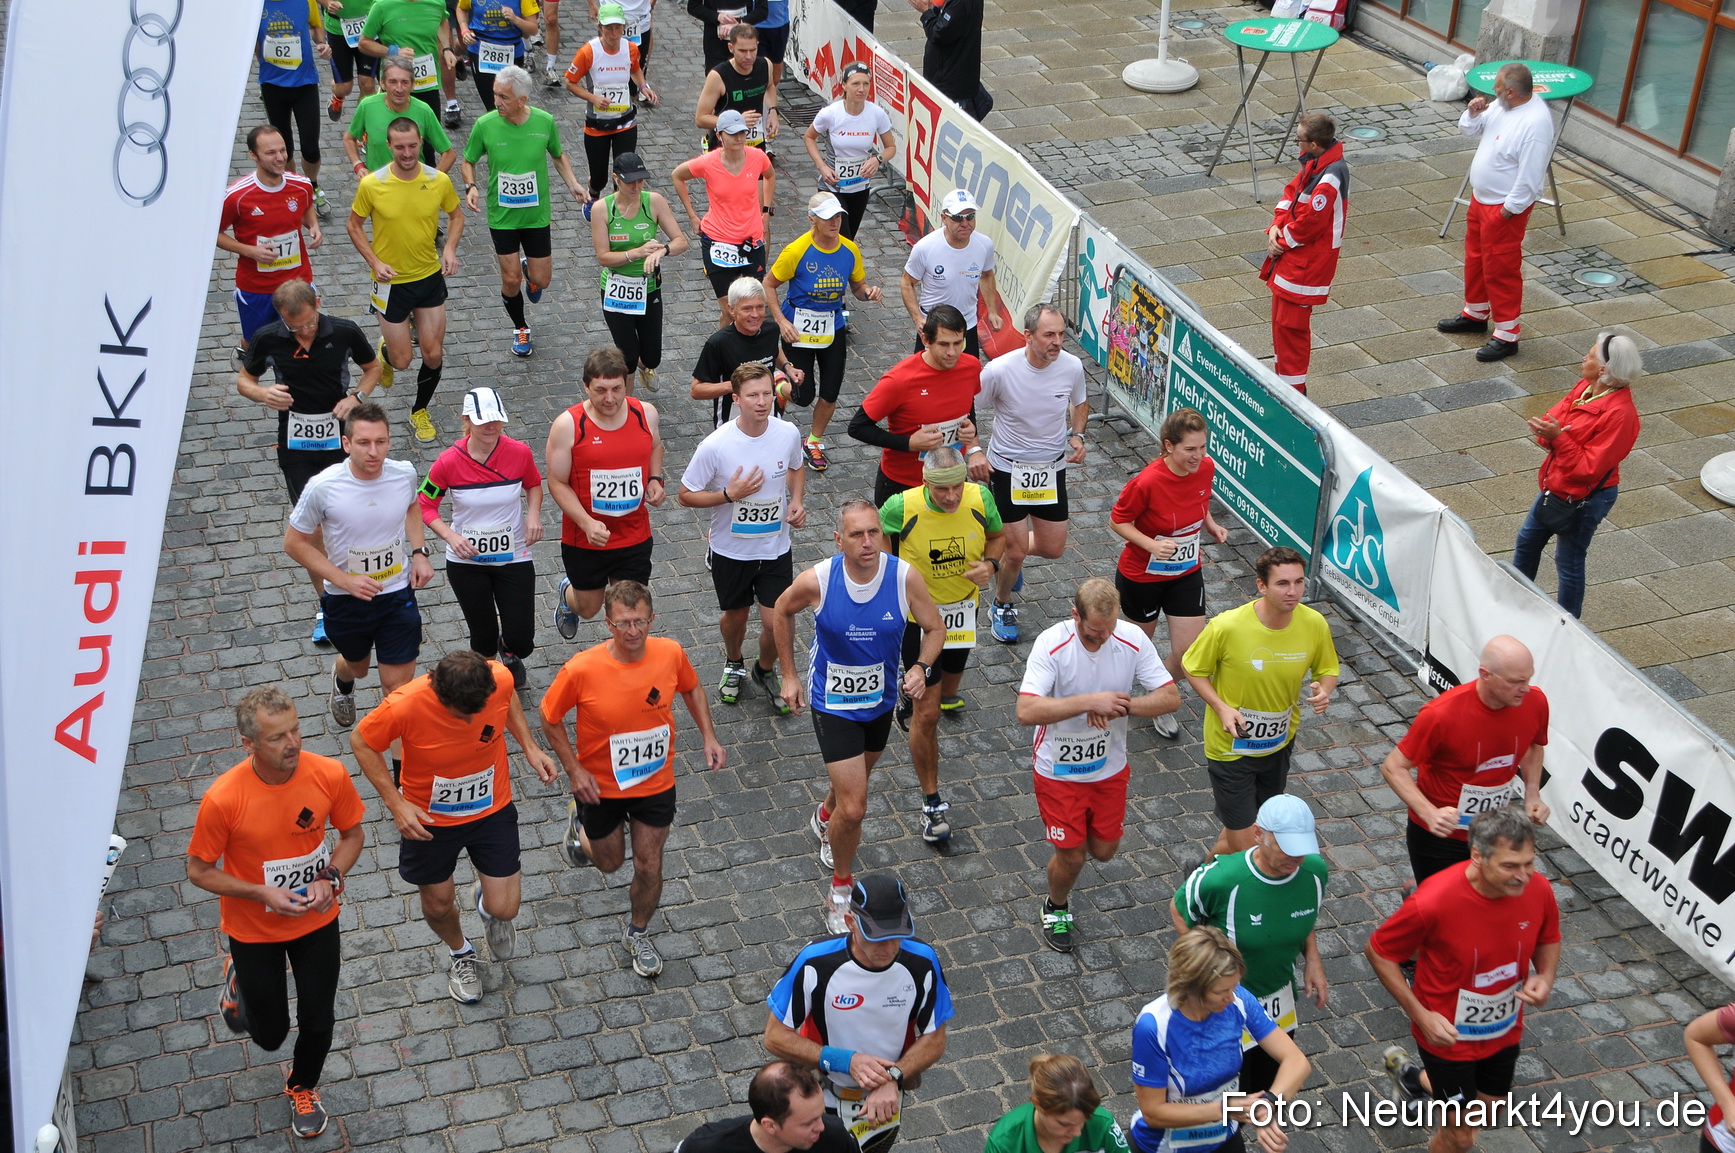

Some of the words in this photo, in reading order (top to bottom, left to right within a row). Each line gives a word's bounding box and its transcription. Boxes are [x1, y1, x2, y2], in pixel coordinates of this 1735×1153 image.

[275, 46, 290, 58] 62
[483, 50, 510, 64] 2881
[602, 91, 623, 104] 127
[502, 181, 534, 195] 2339
[609, 283, 643, 300] 2056
[611, 301, 637, 309] Katharina
[803, 319, 827, 333] 241
[1195, 350, 1265, 417] Event-Leit-Systeme
[85, 293, 153, 497] BKK
[1174, 371, 1204, 412] Mehr
[1206, 399, 1266, 467] Sicherheit
[294, 422, 335, 438] 2892
[1209, 430, 1247, 479] Event!
[1021, 472, 1048, 488] 302
[596, 479, 638, 498] 2216
[605, 502, 630, 510] Markus
[738, 506, 779, 522] 3332
[1218, 479, 1236, 503] Line:
[1236, 497, 1259, 522] 09181
[1260, 516, 1280, 542] 6352
[369, 544, 394, 555] Neumarkt
[361, 551, 394, 572] 118
[1378, 604, 1400, 628] GmbH
[54, 540, 127, 764] Audi
[831, 674, 879, 693] 2923
[1246, 718, 1288, 738] 2035
[611, 737, 633, 745] PARTL
[633, 732, 660, 743] Neumarkt
[1076, 734, 1103, 743] Neumarkt
[618, 739, 664, 766] 2145
[1060, 740, 1106, 762] 2346
[631, 766, 651, 776] Franz
[1068, 764, 1096, 774] Jochen
[458, 775, 486, 786] Neumarkt
[438, 779, 488, 803] 2115
[266, 864, 292, 873] PARTL
[292, 853, 321, 868] Neumarkt
[1569, 800, 1722, 948] stadtwerke
[834, 994, 856, 1005] tkn
[1460, 995, 1486, 1006] PARTL
[1464, 996, 1517, 1023] 2231
